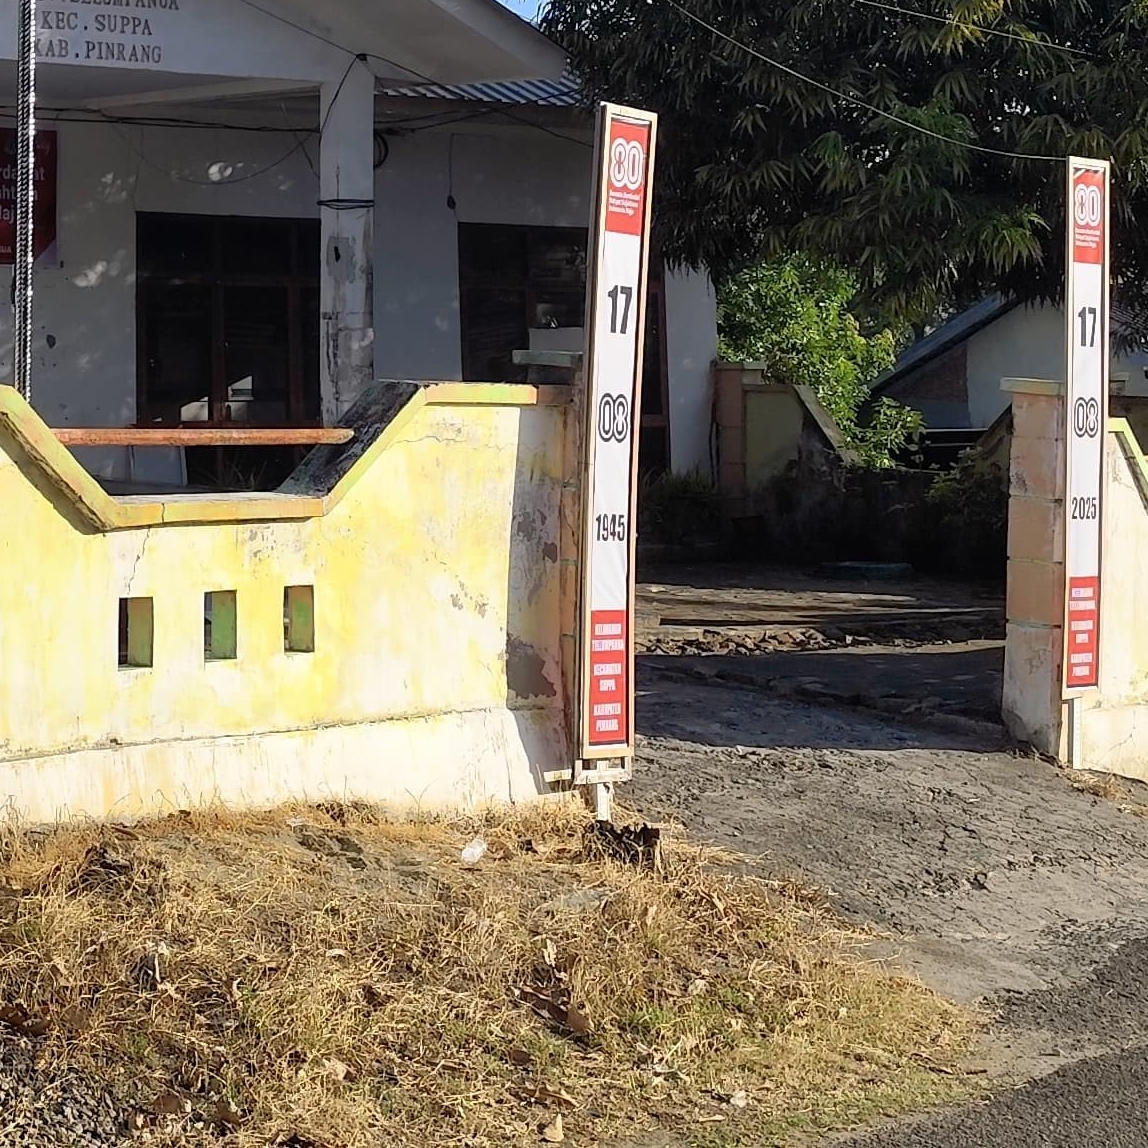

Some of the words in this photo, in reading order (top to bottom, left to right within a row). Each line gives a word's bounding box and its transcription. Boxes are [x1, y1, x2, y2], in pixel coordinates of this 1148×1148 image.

[609, 138, 643, 190] 80
[1075, 183, 1101, 227] 80
[607, 285, 633, 335] 17
[1077, 306, 1096, 347] 17
[598, 393, 628, 443] 08
[1074, 397, 1098, 438] 08
[595, 513, 626, 542] 1945
[1071, 497, 1097, 520] 2025
